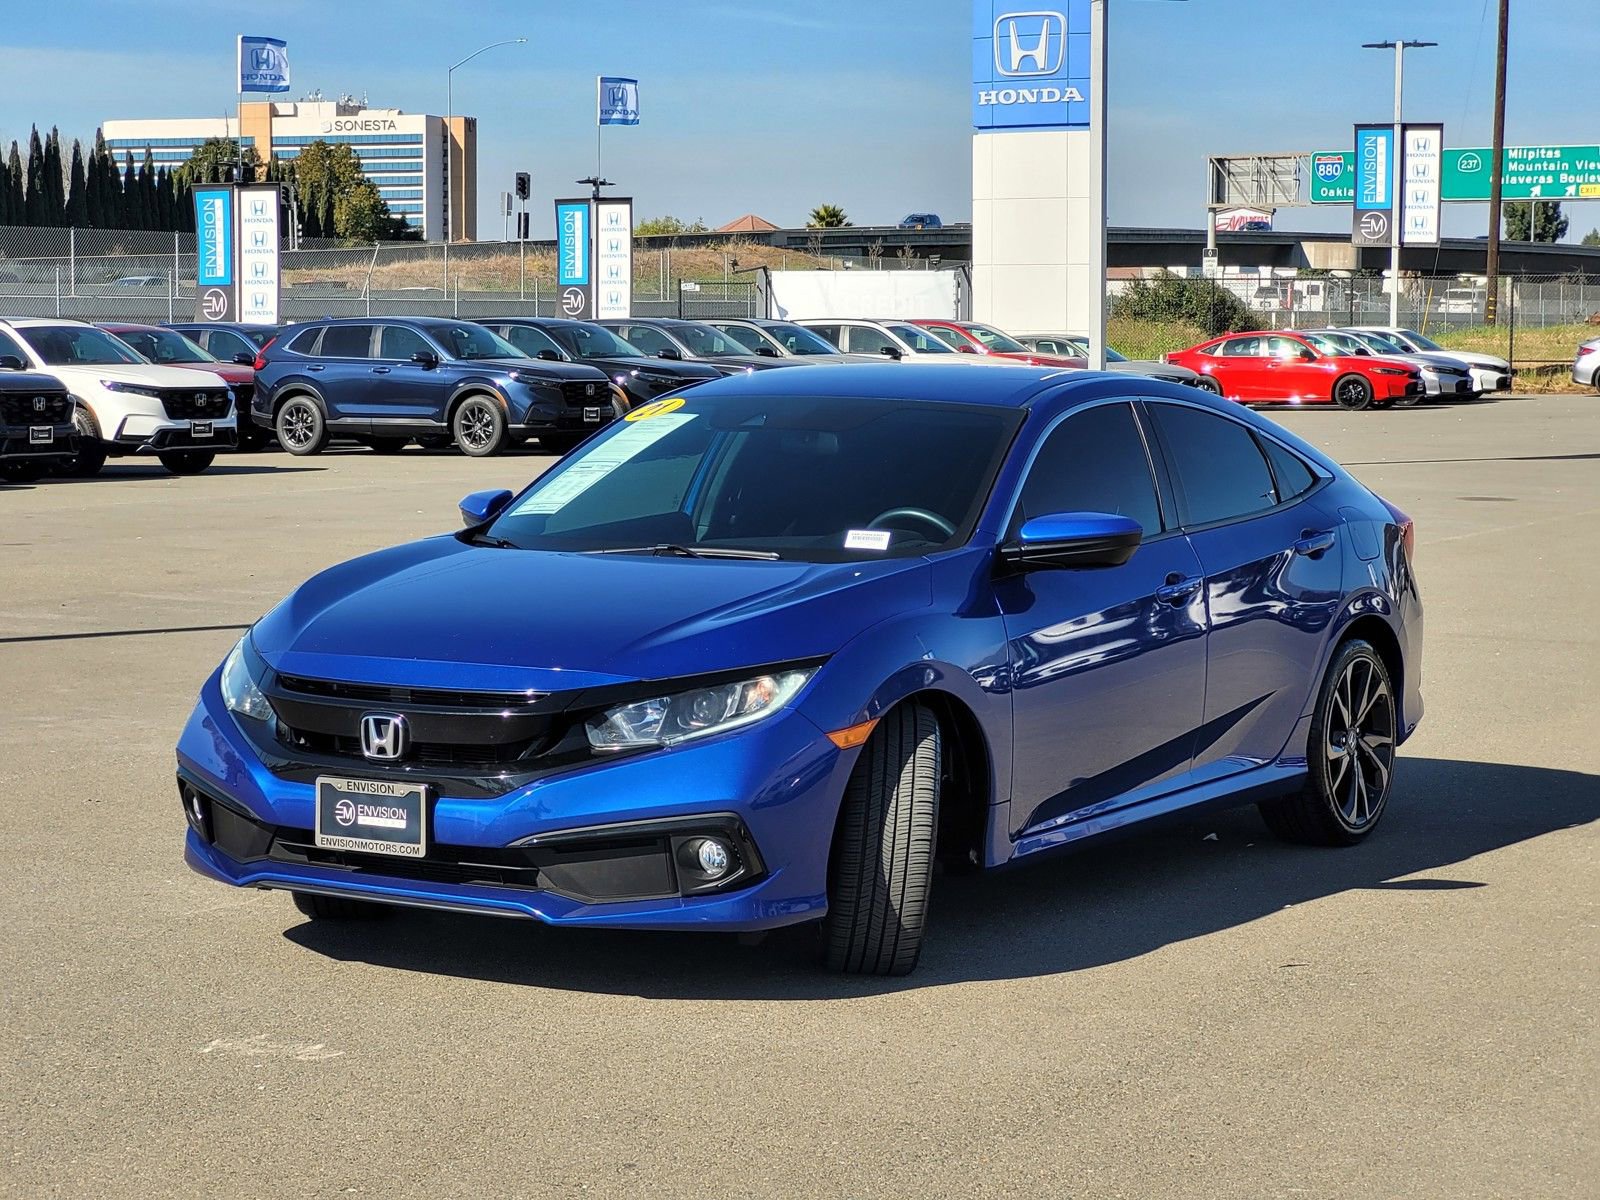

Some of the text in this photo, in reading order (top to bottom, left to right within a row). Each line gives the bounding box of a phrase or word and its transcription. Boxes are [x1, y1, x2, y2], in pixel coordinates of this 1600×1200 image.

[241, 73, 287, 82] HONDA
[978, 87, 1085, 105] HONDA
[600, 109, 639, 117] HONDA
[334, 119, 397, 132] SONESTA
[1508, 148, 1561, 160] Milpitas
[1318, 164, 1341, 176] 880
[1363, 135, 1377, 204] ENVISION
[1461, 159, 1478, 169] 237
[1508, 160, 1569, 172] Mountain
[1320, 187, 1354, 197] Oakla
[1580, 186, 1597, 194] EXIT
[202, 198, 216, 278] ENVISION
[563, 210, 575, 279] ENVISION
[346, 781, 395, 795] ENVISION
[357, 804, 407, 820] ENVISION
[320, 837, 420, 855] ENVISIONMOTORS.COM
